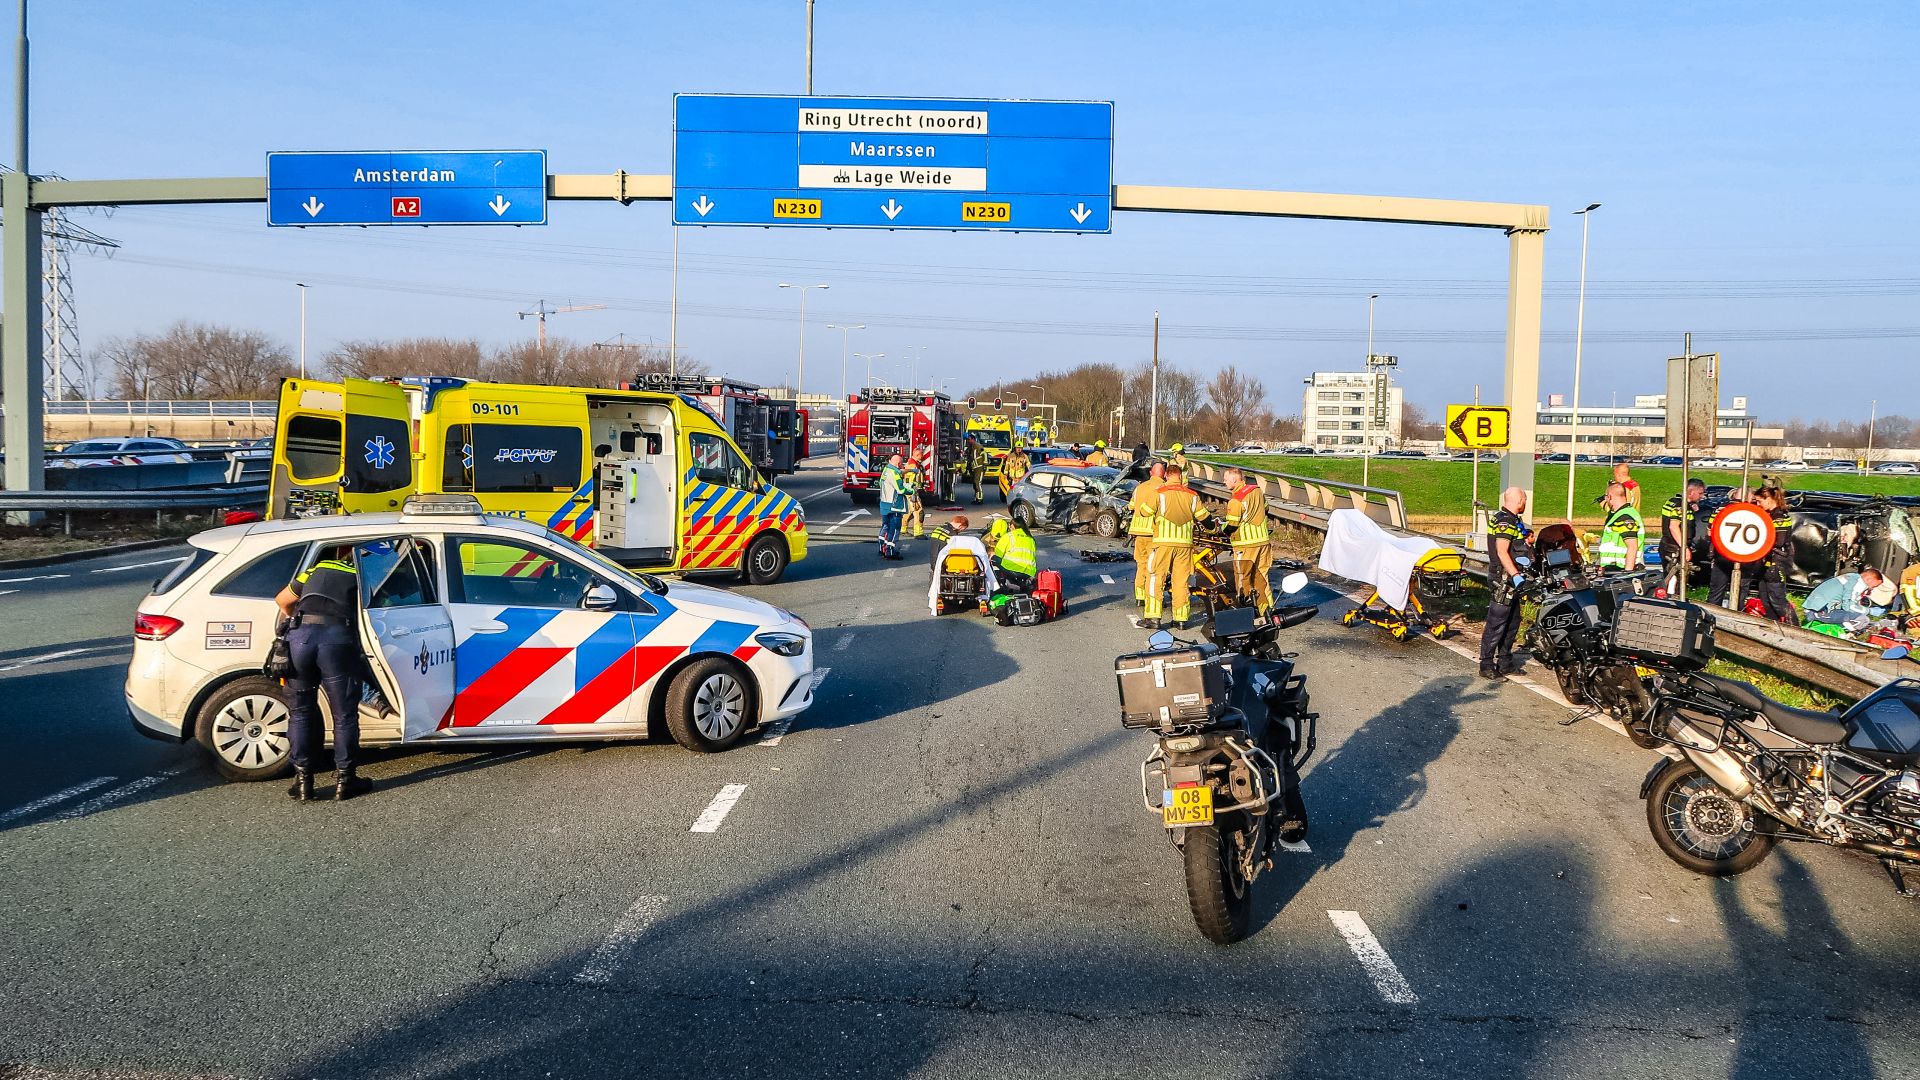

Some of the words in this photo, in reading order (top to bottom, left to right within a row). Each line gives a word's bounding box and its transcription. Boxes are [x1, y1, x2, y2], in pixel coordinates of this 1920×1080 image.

[805, 111, 841, 129] Ring
[848, 112, 912, 128] Utrecht
[919, 114, 982, 130] (noord)
[849, 141, 936, 158] Maarssen
[354, 168, 455, 183] Amsterdam
[855, 170, 893, 186] Lage
[899, 171, 952, 186] Weide
[396, 201, 417, 214] A2
[777, 203, 817, 216] N230
[965, 205, 1006, 220] N230
[472, 402, 520, 416] 09-101
[1477, 416, 1492, 438] B
[1724, 521, 1761, 545] 70
[413, 647, 456, 675] POLITIE
[1181, 790, 1200, 804] 08
[1166, 805, 1210, 821] MV-ST
